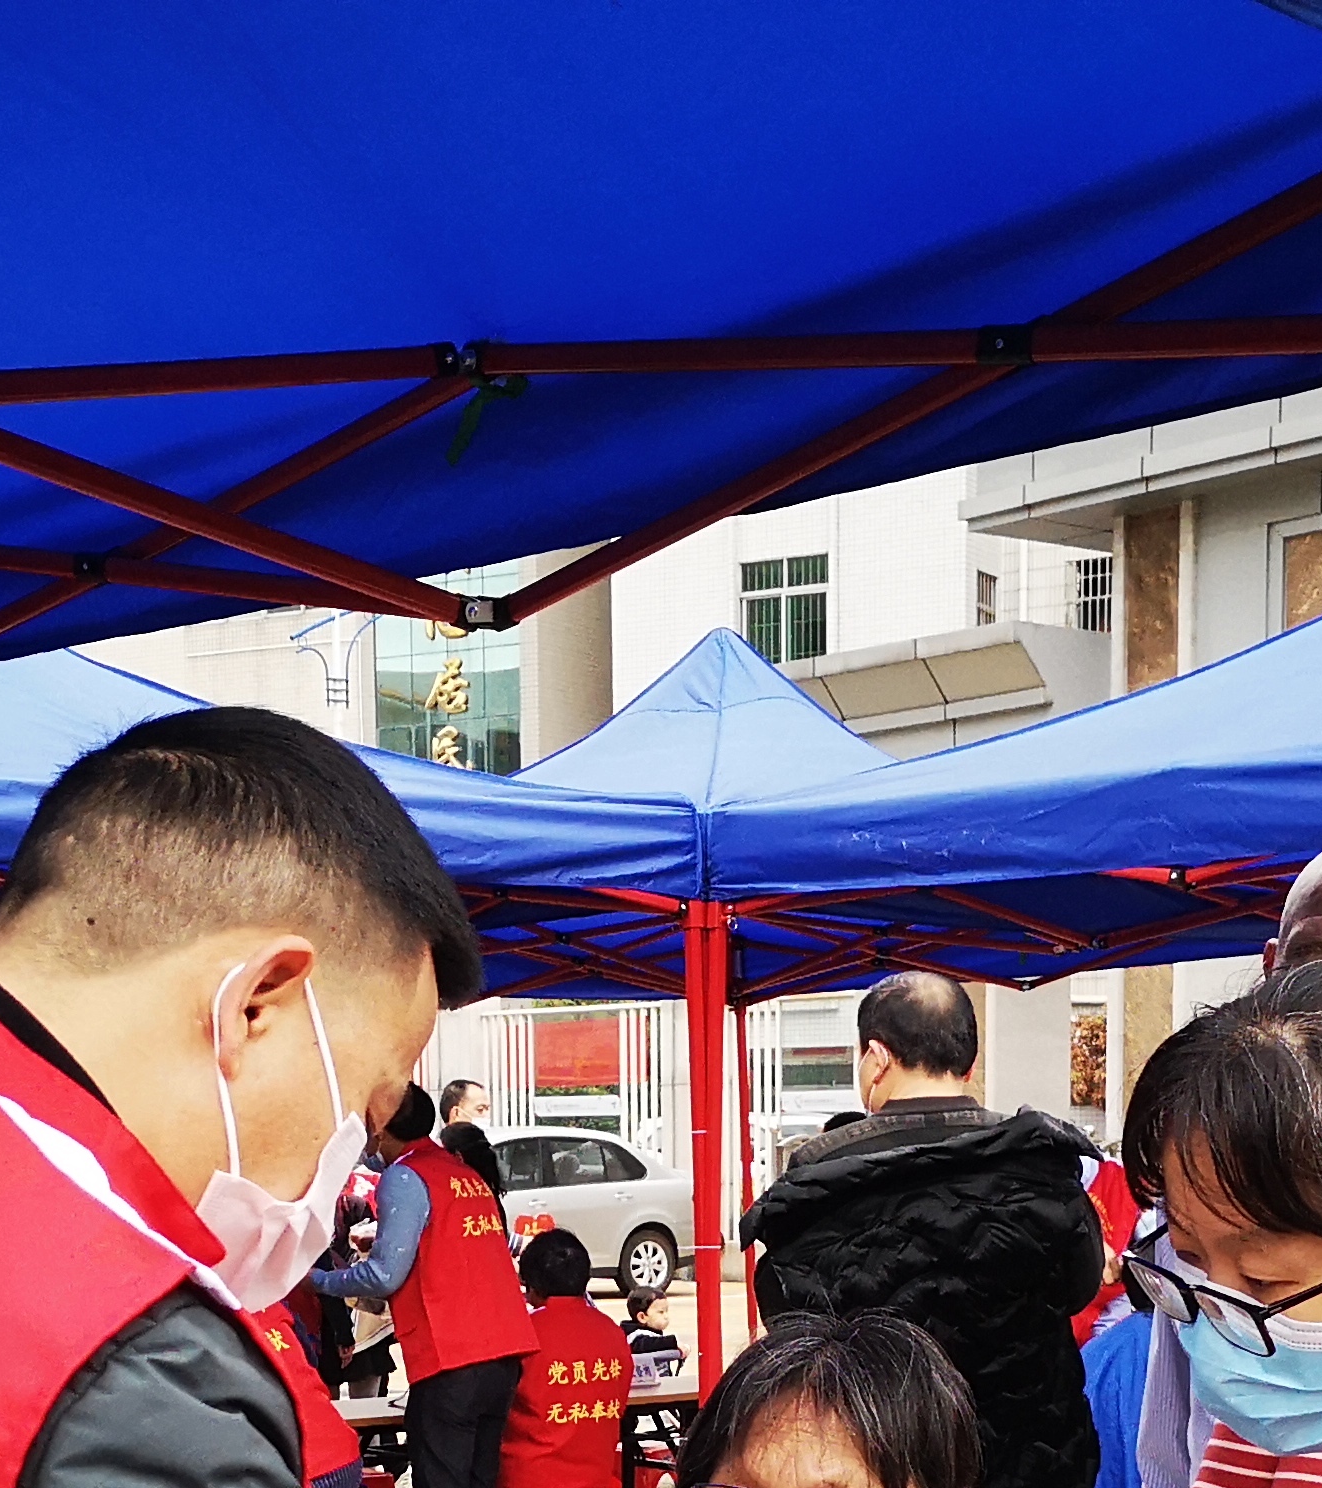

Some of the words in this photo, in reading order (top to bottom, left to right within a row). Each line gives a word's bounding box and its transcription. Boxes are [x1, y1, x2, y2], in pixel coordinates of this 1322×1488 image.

[548, 1358, 622, 1385] 党员先锋
[546, 1399, 621, 1424] 无私奉献
